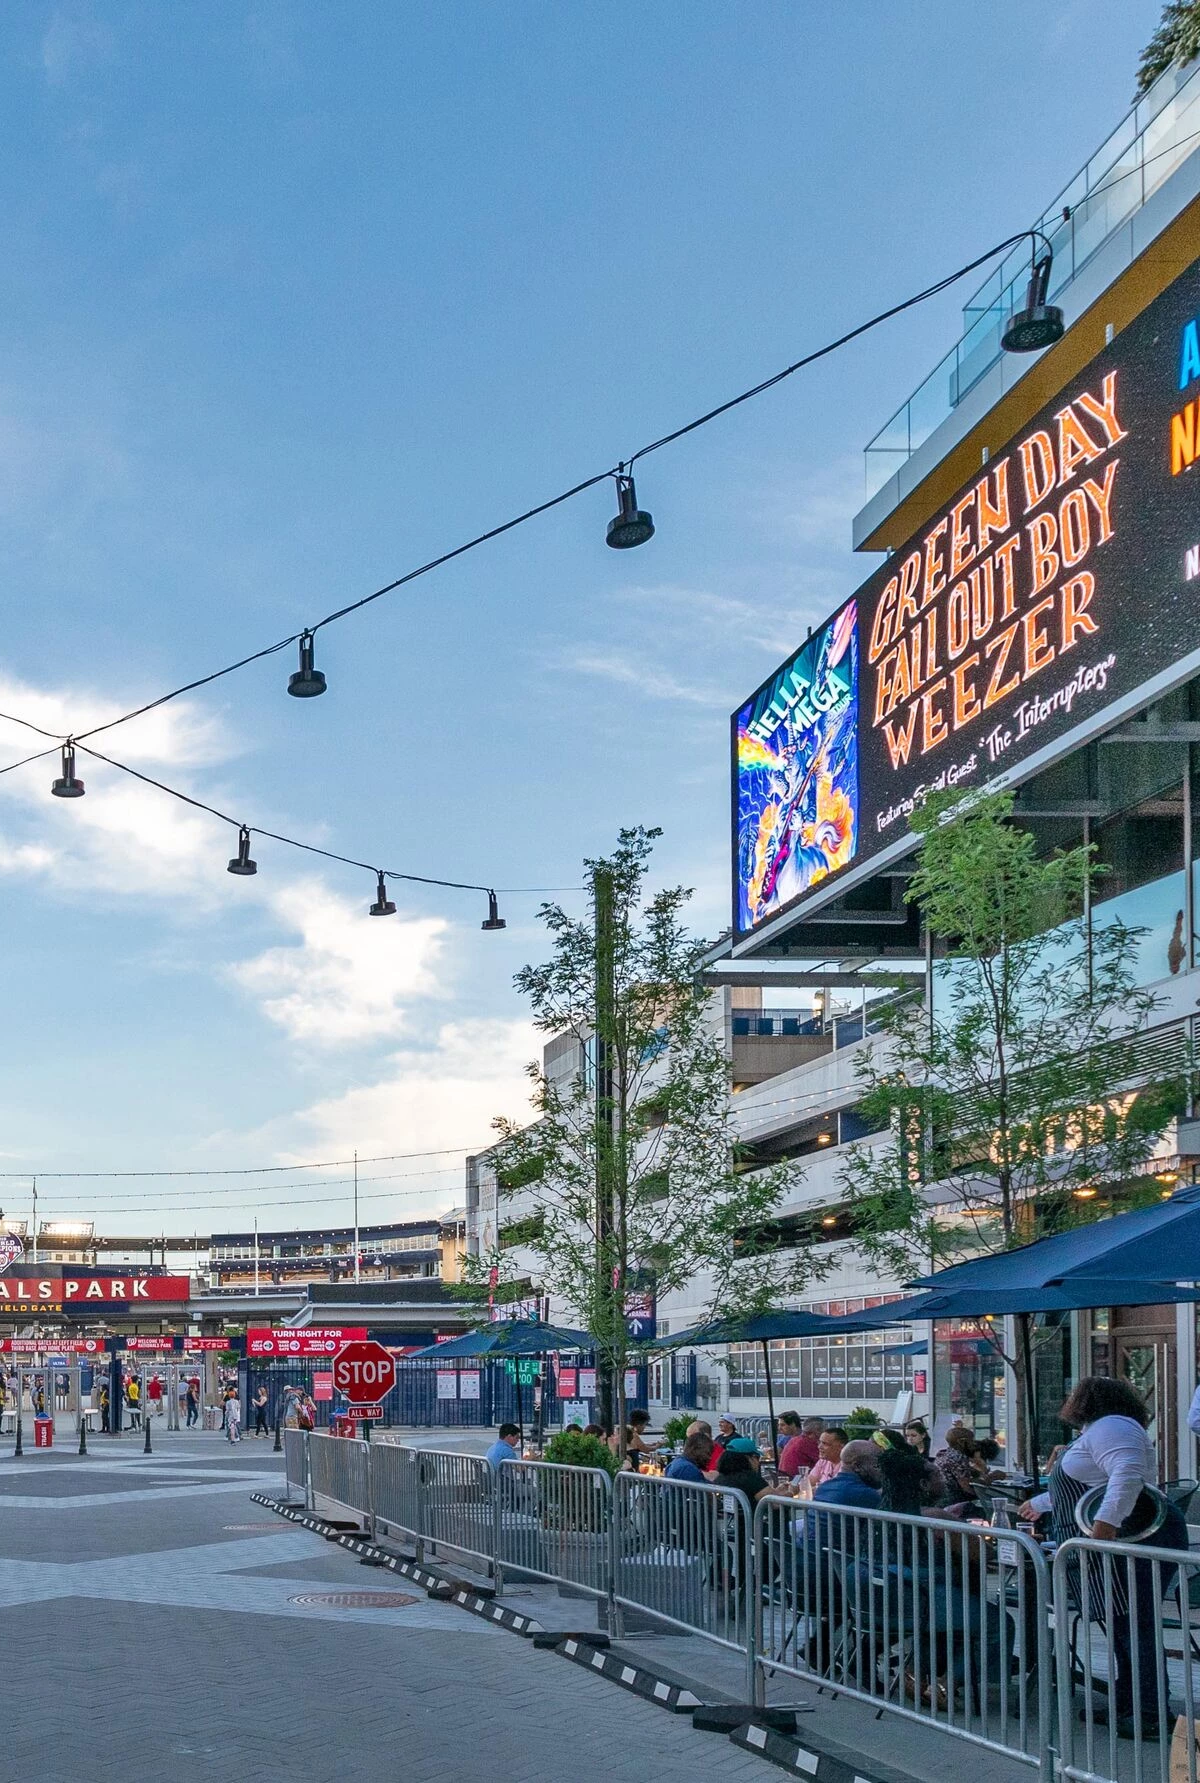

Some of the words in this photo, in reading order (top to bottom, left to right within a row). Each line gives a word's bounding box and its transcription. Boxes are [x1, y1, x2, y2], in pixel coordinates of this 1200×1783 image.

[868, 457, 1011, 662] GREEN
[1017, 370, 1129, 516] DAY
[872, 608, 942, 728] FALL
[948, 531, 1021, 656] OUT
[1030, 458, 1121, 599] BOY
[883, 570, 1099, 770] WEEZER
[749, 671, 812, 743] HELLA
[784, 670, 851, 740] MEGA
[877, 797, 914, 832] Featuring
[913, 771, 946, 806] Spial
[947, 753, 978, 785] Guest
[31, 1304, 63, 1312] GATE
[65, 1279, 150, 1298] PARK
[272, 1330, 296, 1338] TURN
[297, 1330, 323, 1338] RIGHT
[324, 1330, 342, 1338] FOR
[337, 1360, 391, 1384] STOP
[513, 1374, 532, 1384] 100
[350, 1409, 364, 1417] ALL
[366, 1408, 381, 1416] WAY
